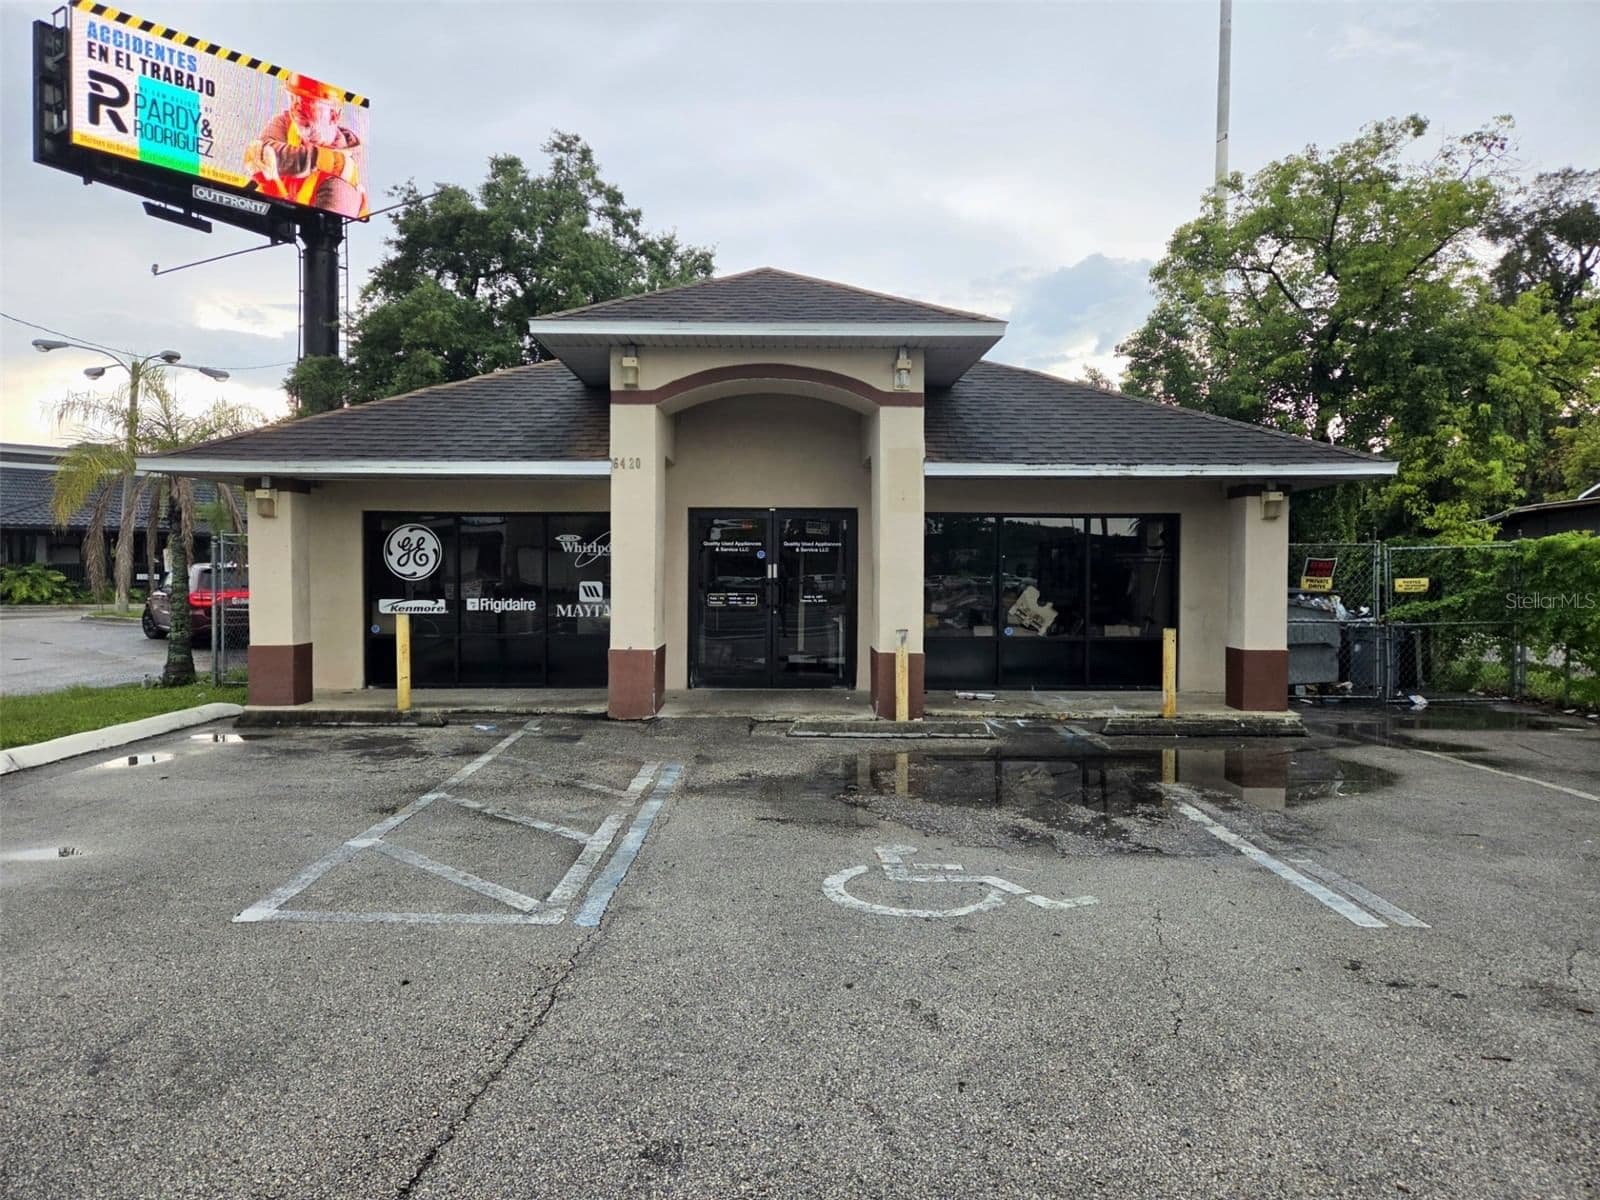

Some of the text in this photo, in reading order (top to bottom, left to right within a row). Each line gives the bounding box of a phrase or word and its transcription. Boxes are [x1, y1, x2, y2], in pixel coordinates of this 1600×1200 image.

[87, 20, 198, 72] ACCIDENTES
[87, 40, 216, 97] EN EL TRABAJO
[134, 92, 202, 134] PARDY
[201, 118, 214, 139] &
[134, 119, 214, 158] RODRIGUEZ
[389, 604, 444, 613] Kenmore
[480, 598, 537, 613] Frigidaire
